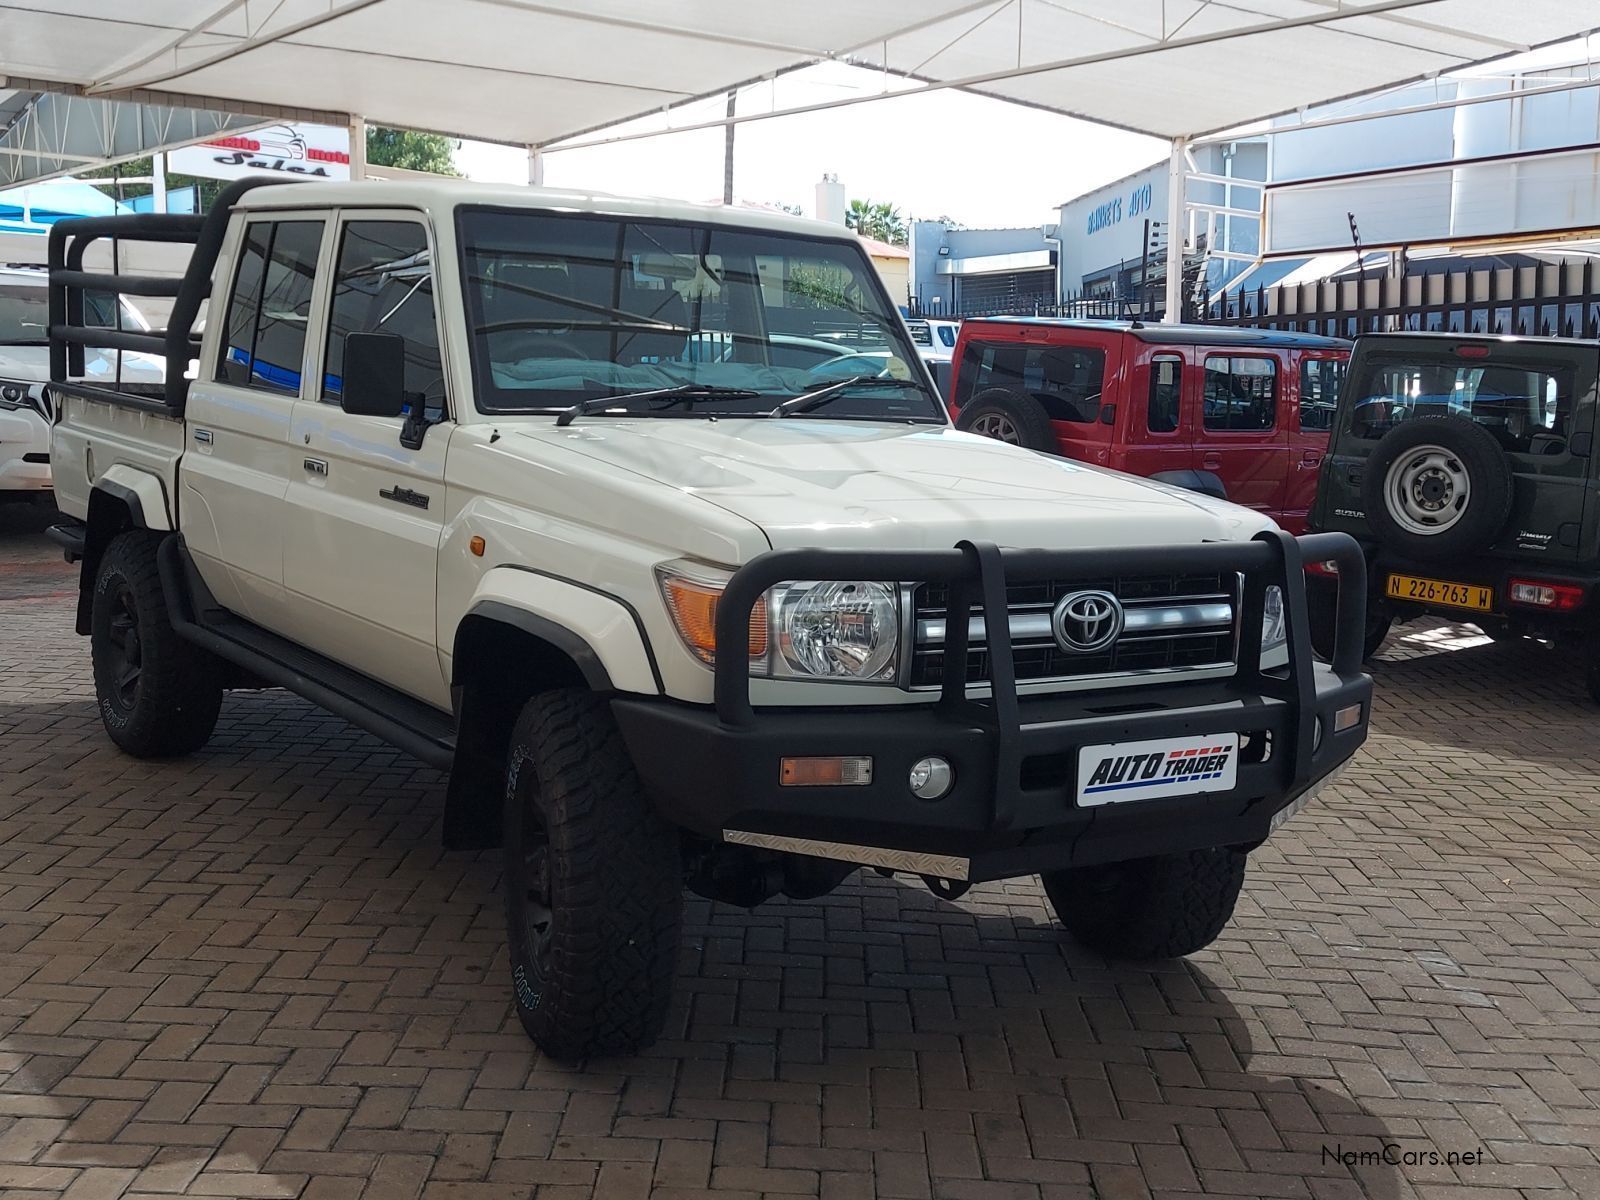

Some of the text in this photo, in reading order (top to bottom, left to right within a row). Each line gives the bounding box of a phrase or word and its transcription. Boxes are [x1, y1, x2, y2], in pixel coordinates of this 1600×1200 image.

[213, 152, 331, 177] Sales
[1128, 183, 1152, 218] AUTO
[1391, 576, 1488, 608] N 226-763 W
[1087, 752, 1229, 786] AUTO TRADER
